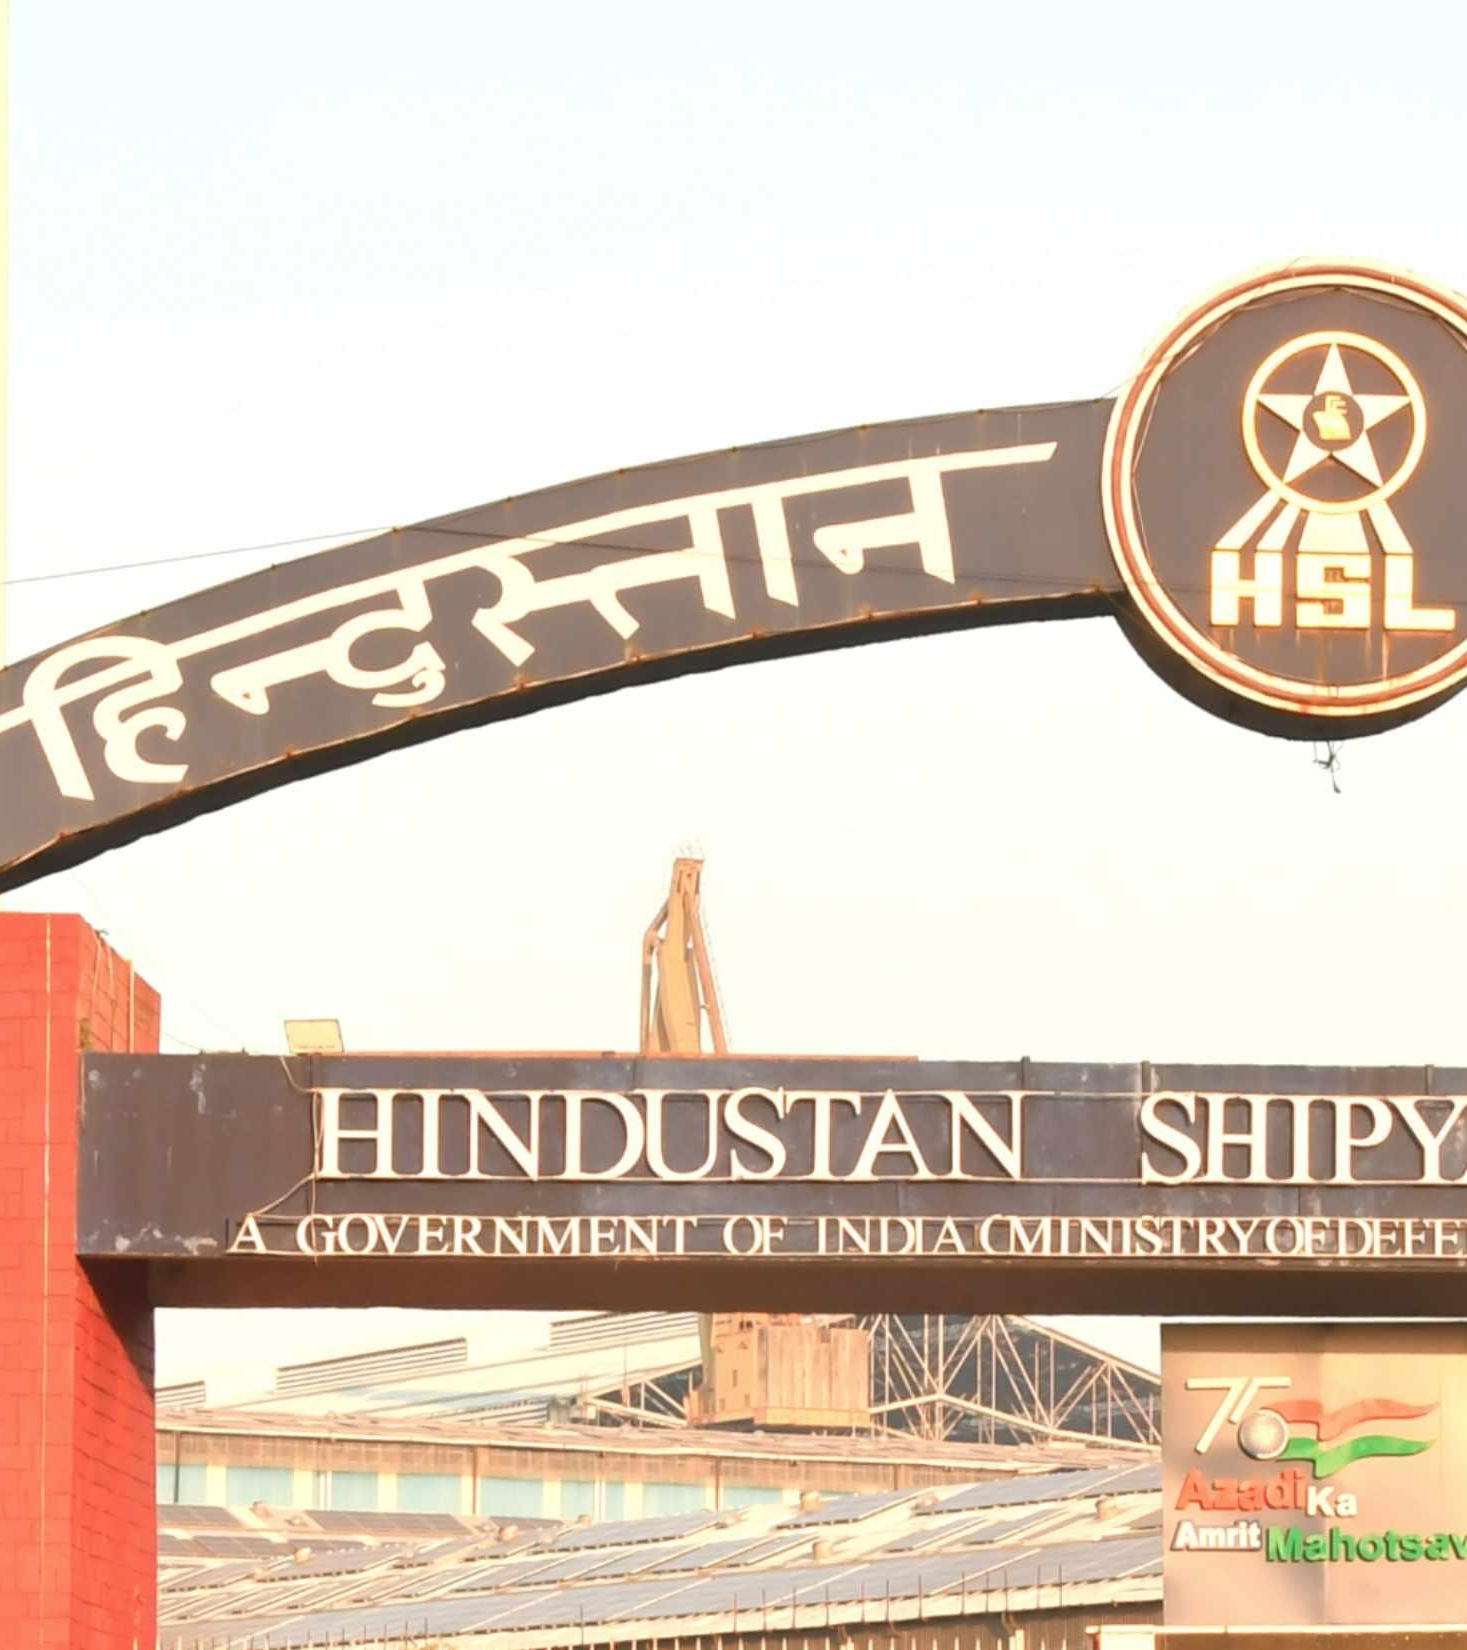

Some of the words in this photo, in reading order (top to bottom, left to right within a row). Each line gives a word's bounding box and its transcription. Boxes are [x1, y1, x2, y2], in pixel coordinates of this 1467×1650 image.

[1210, 549, 1457, 631] HSL
[313, 1086, 1028, 1182] HINDUSTAN
[227, 1214, 268, 1254] A
[296, 1214, 698, 1256] GOVERNMENT
[722, 1215, 788, 1256] OF
[817, 1216, 968, 1256] INDIA
[1176, 1467, 1306, 1512] Azadi
[1305, 1486, 1358, 1518] Ka
[1170, 1520, 1263, 1552] Amrit
